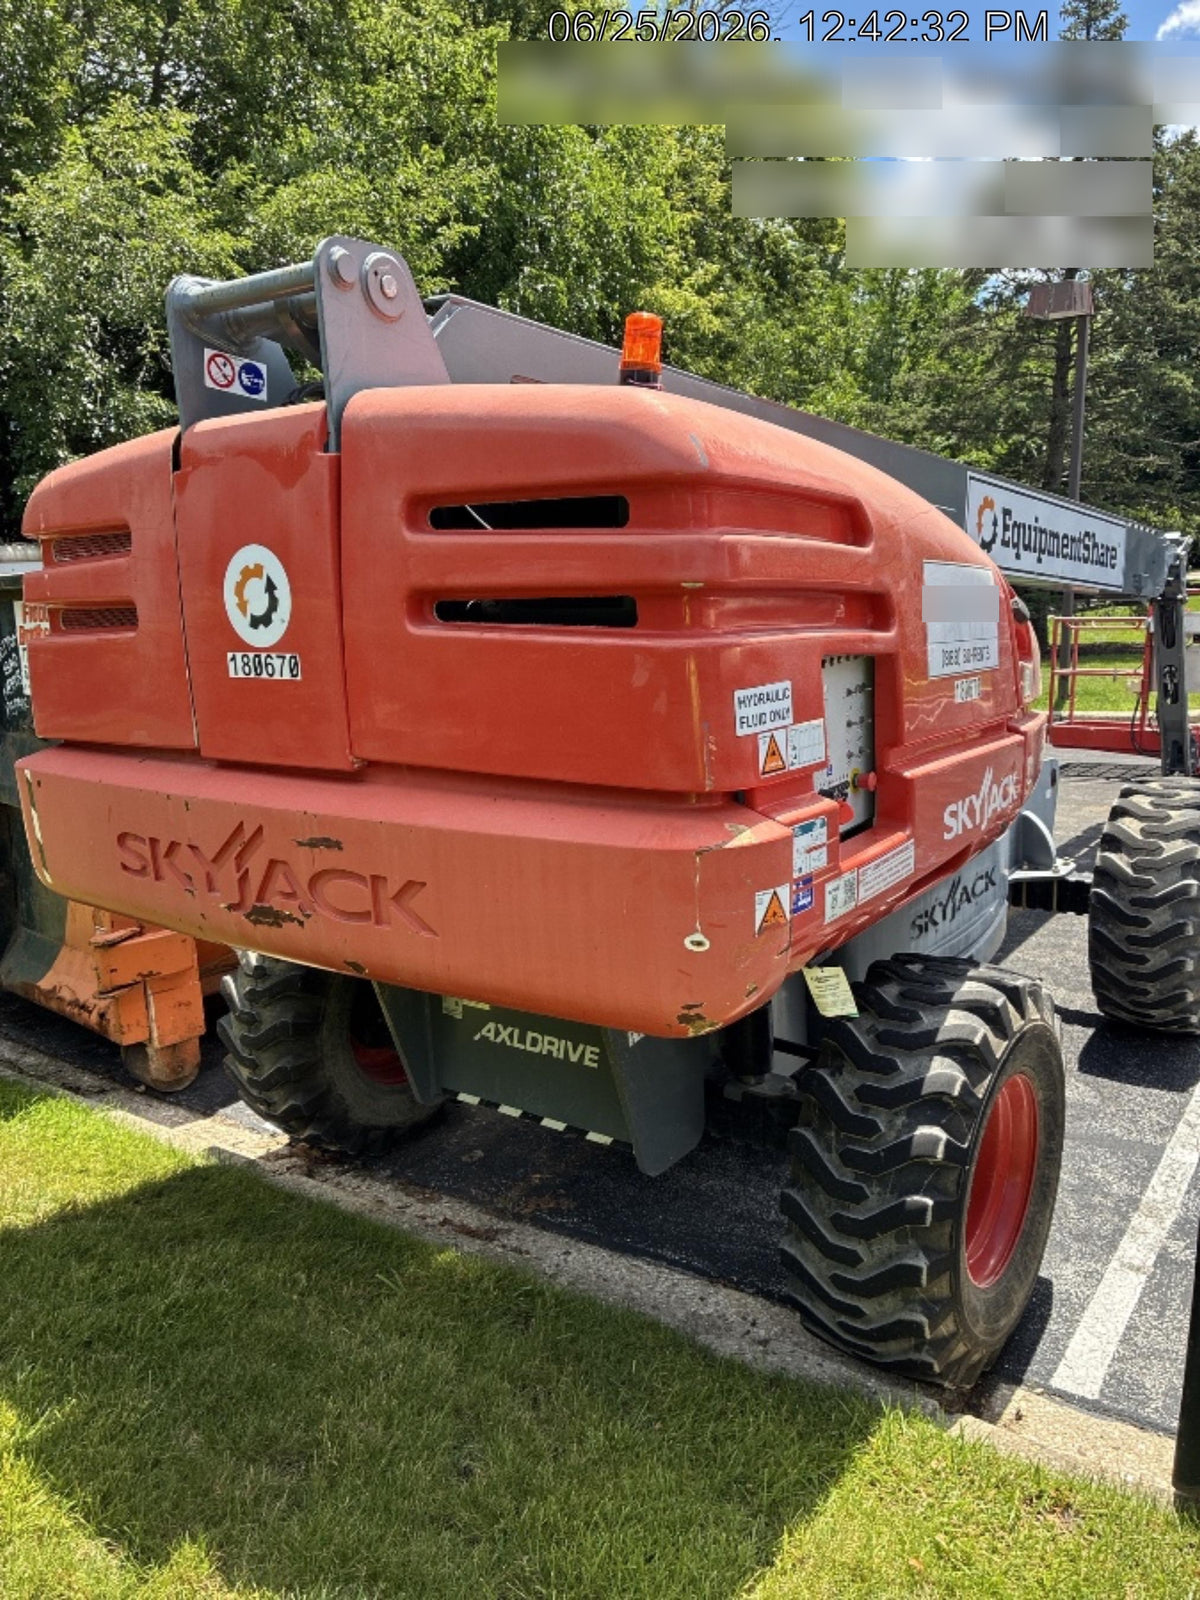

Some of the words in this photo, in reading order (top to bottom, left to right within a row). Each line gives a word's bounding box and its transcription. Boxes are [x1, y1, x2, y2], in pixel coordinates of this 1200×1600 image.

[1001, 506, 1118, 569] EquipmentShare
[230, 653, 299, 678] 180670
[737, 687, 790, 710] HYDRAULIC
[739, 712, 767, 730] FLUID
[769, 706, 790, 722] ONLY
[943, 765, 1018, 840] SKYJACK
[116, 820, 439, 938] SKYJACK
[910, 865, 996, 939] SKYJACK
[473, 1021, 601, 1068] AXLDRIVE
